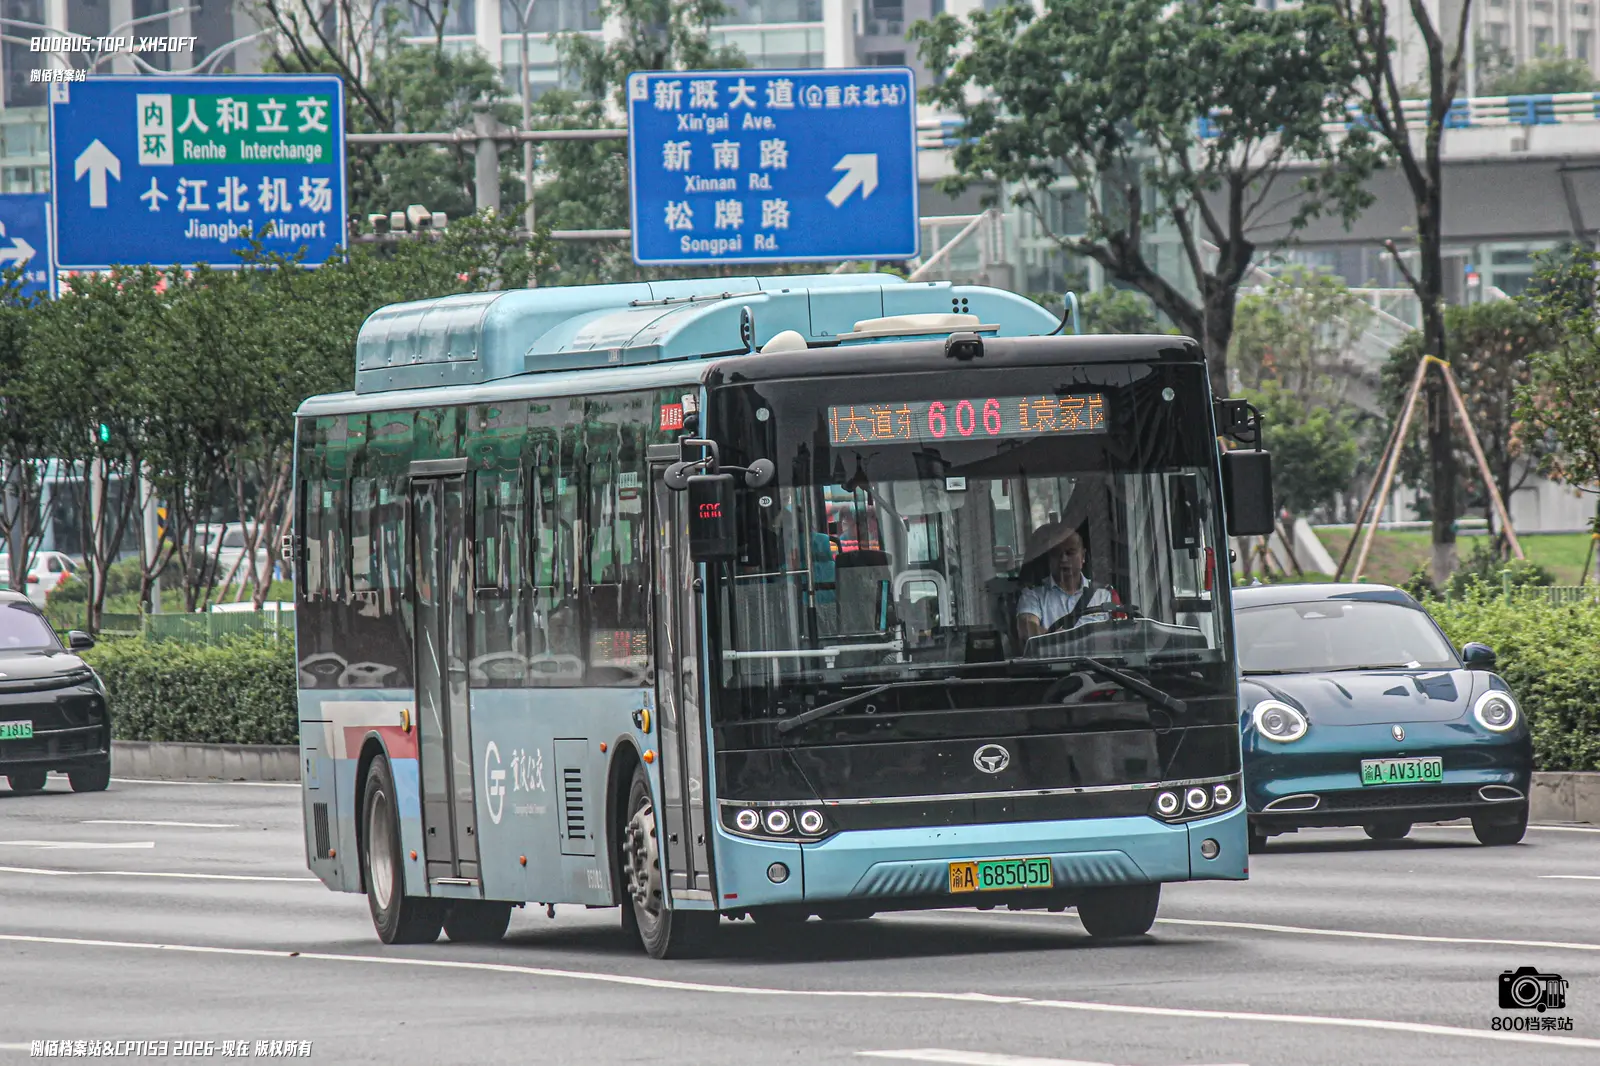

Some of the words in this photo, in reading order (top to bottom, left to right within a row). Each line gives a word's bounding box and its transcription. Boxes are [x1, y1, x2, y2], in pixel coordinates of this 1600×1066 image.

[654, 78, 795, 111] 新溉大道
[177, 97, 329, 134] 人和立交
[677, 112, 729, 134] Xin'gai
[742, 113, 776, 130] Ave.
[143, 102, 166, 159] 内环
[183, 140, 227, 160] Renhe
[240, 140, 322, 164] Interchange
[663, 138, 788, 171] 新南路
[176, 176, 332, 213] 江北机场
[684, 174, 736, 192] Xinnan
[748, 173, 773, 190] Rd.
[664, 198, 790, 231] 松牌路
[266, 218, 326, 242] Airport
[680, 235, 742, 255] Songpai
[754, 234, 779, 250] Rd.
[829, 403, 911, 443] 大道
[928, 398, 1002, 438] 606
[1389, 761, 1441, 780] AV3180
[983, 862, 1049, 886] 68505D
